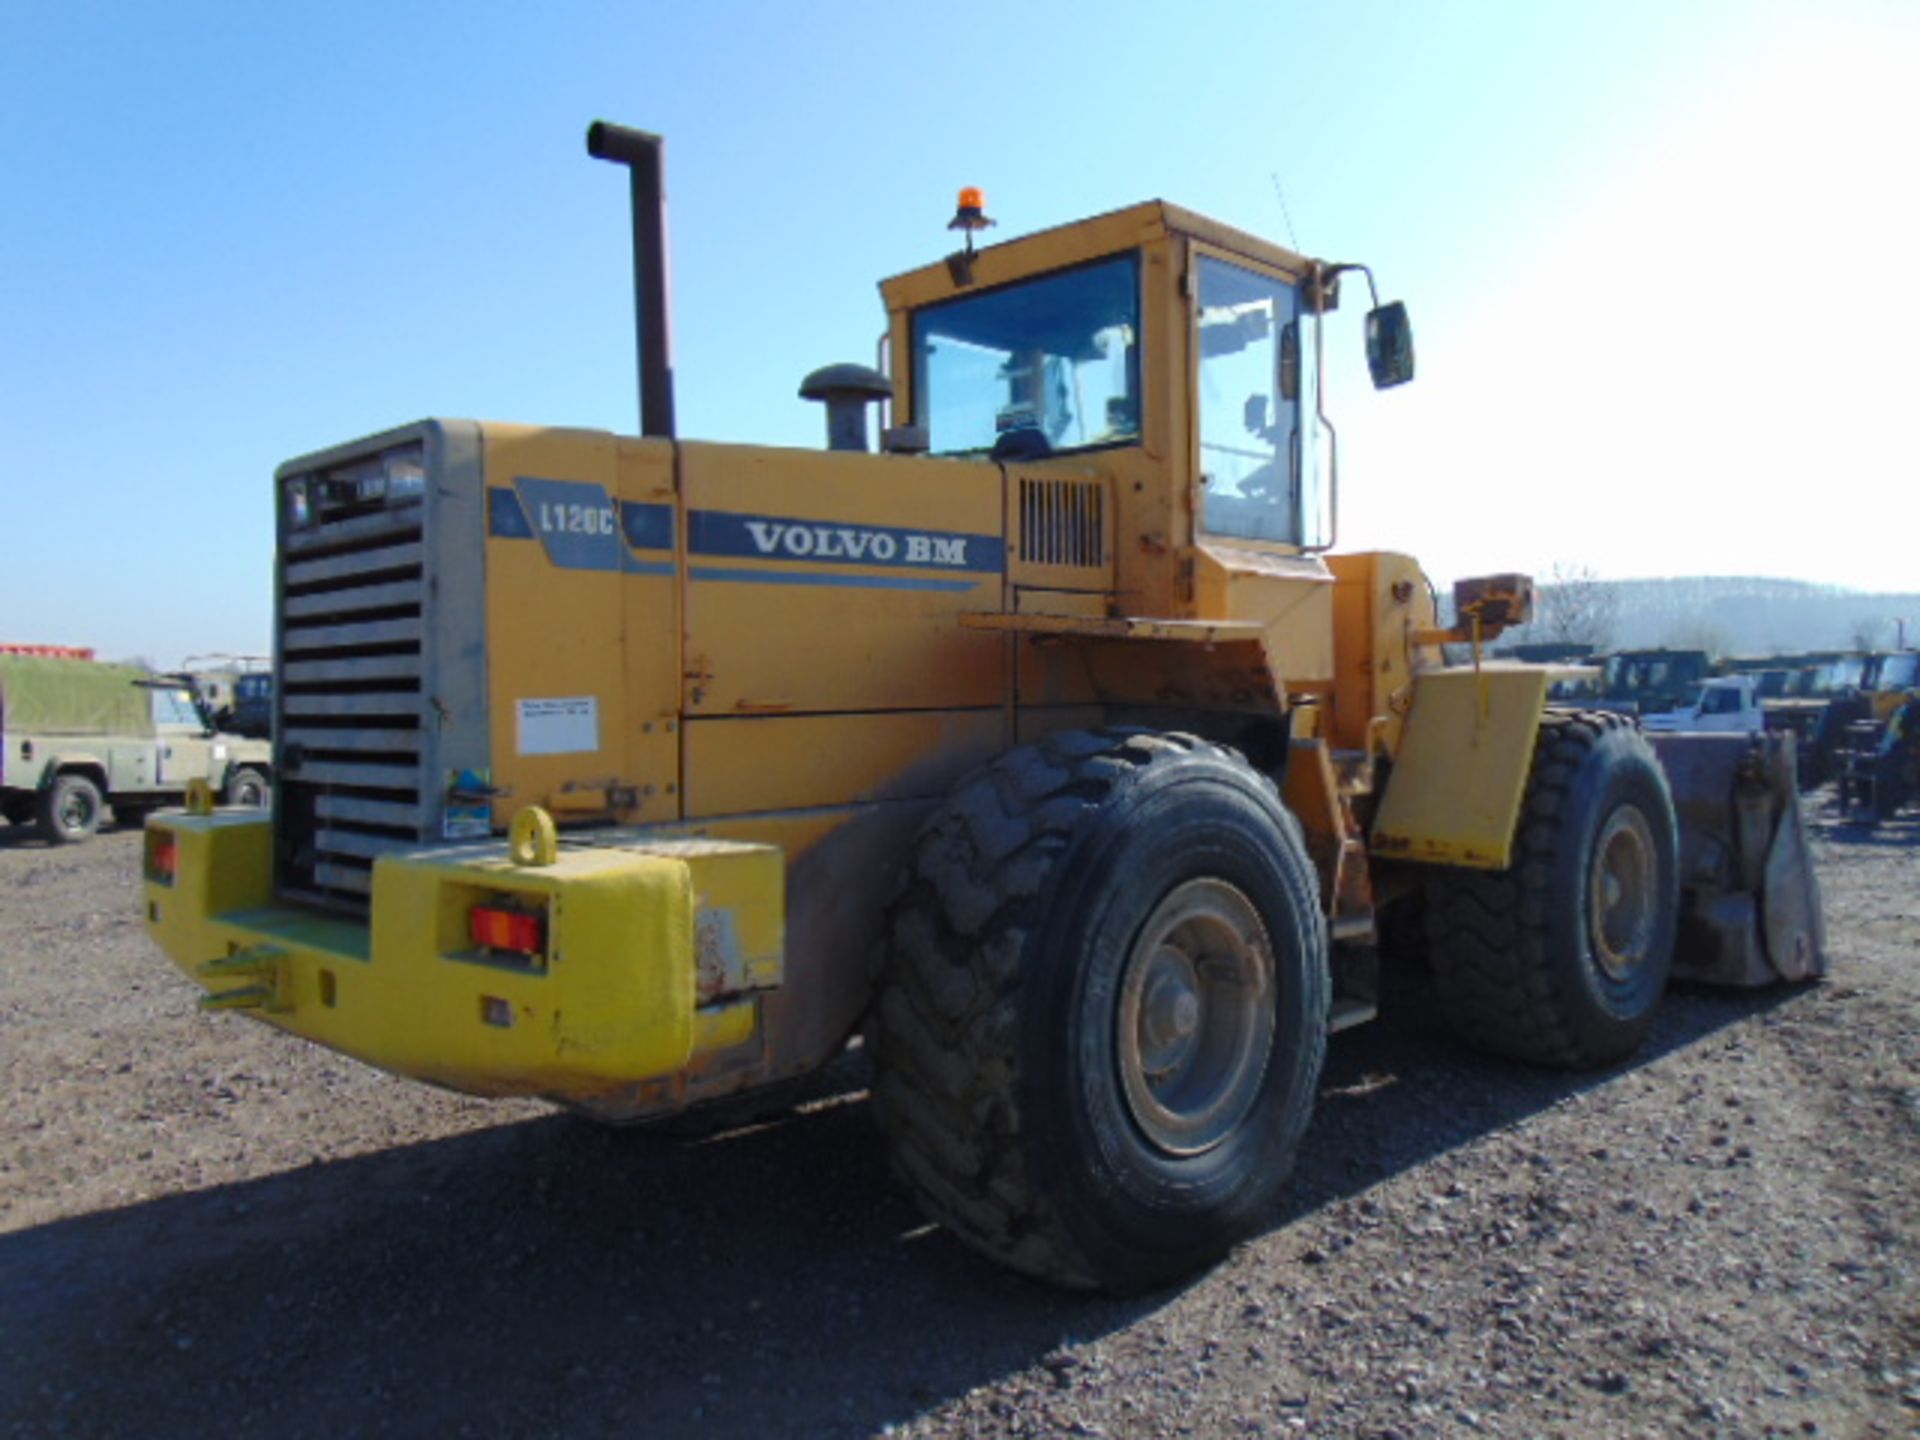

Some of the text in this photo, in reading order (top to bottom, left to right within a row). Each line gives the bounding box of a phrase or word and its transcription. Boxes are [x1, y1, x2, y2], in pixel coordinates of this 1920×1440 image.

[541, 503, 614, 535] L120C
[746, 521, 968, 565] VOLVO BM
